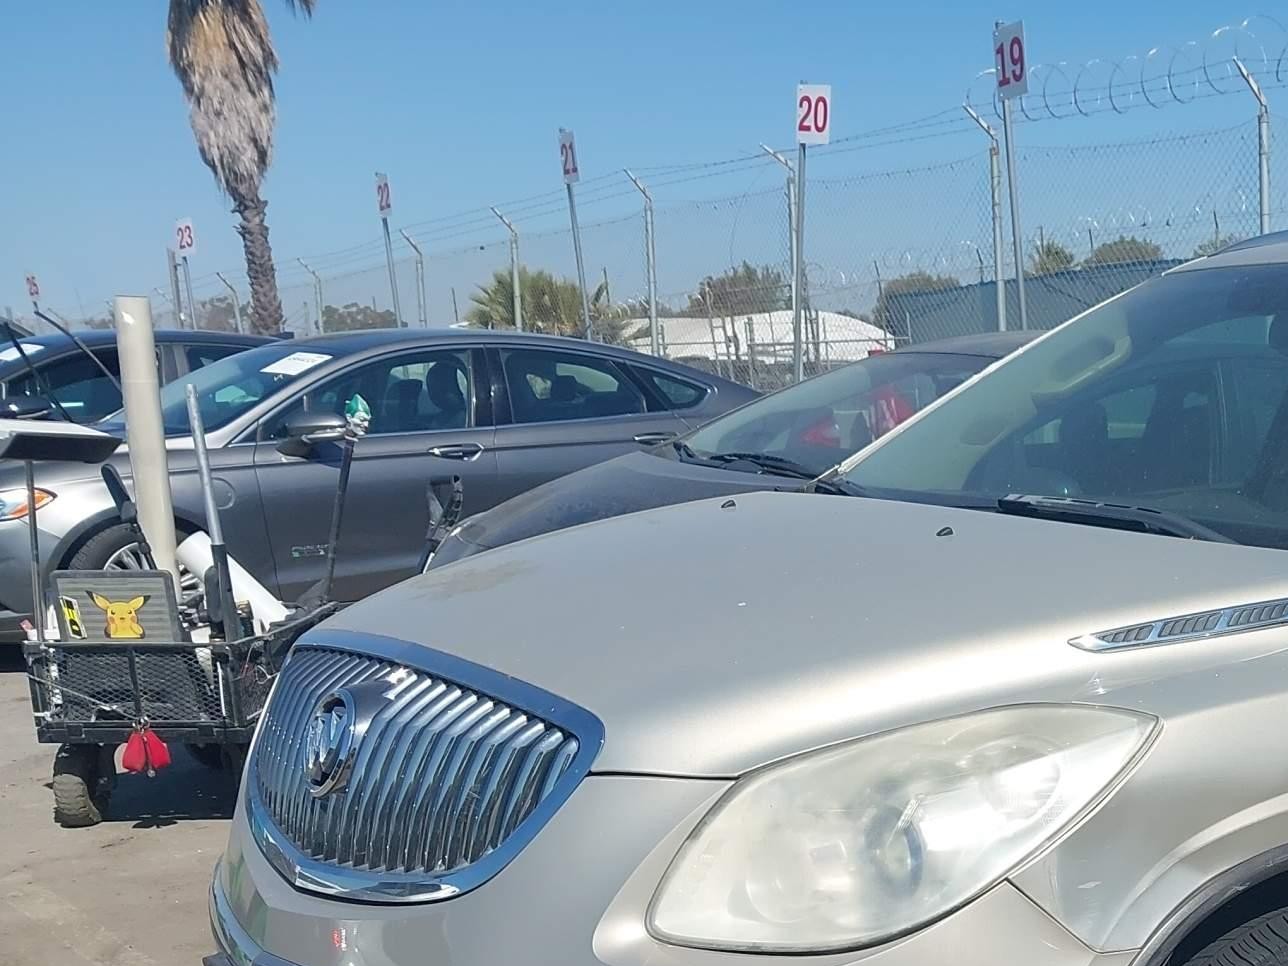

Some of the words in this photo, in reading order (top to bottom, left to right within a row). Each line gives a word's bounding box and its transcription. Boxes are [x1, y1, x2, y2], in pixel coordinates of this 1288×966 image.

[995, 36, 1024, 87] 19
[798, 95, 828, 133] 20
[561, 142, 578, 175] 21
[377, 182, 391, 211] 22
[176, 225, 193, 249] 23
